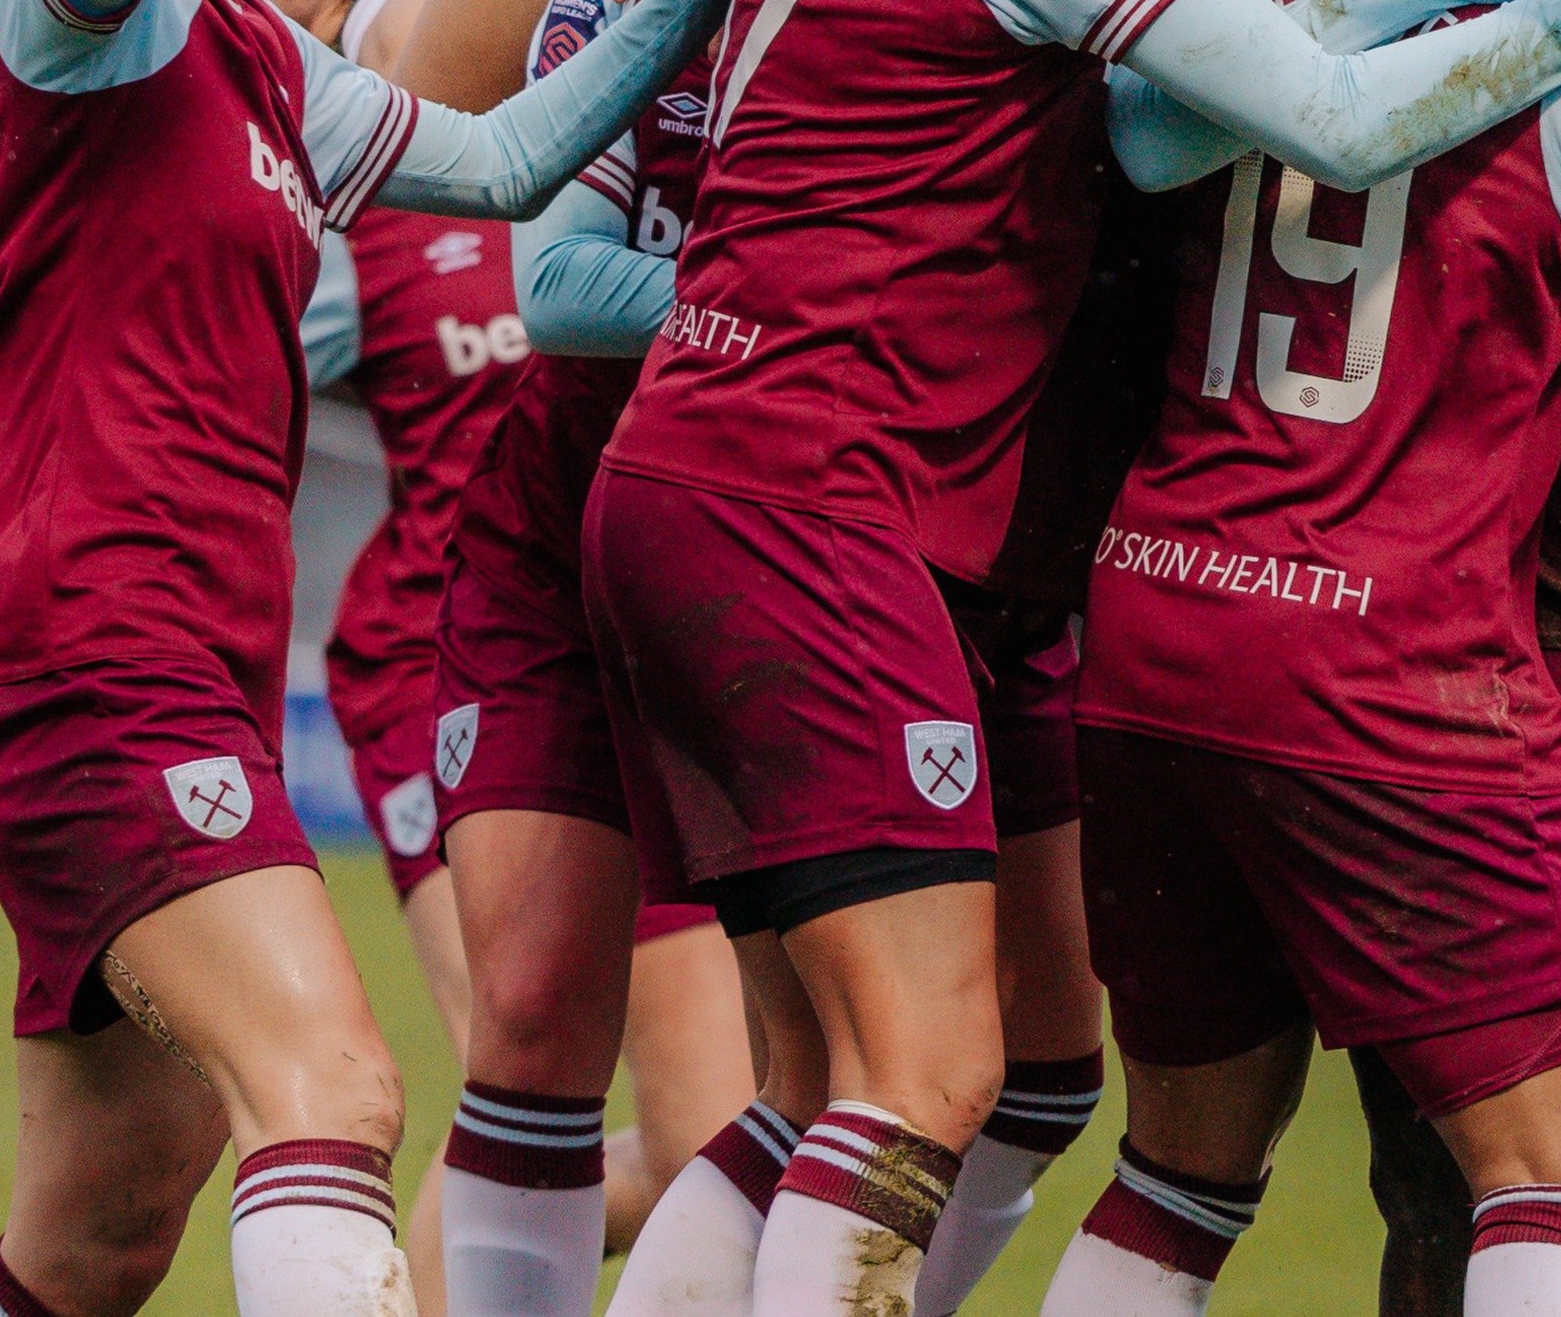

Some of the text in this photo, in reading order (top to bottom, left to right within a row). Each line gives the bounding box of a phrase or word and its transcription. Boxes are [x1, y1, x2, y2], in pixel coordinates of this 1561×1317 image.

[658, 117, 705, 137] umbro
[246, 120, 325, 251] betw
[1200, 147, 1414, 424] 19
[1114, 532, 1200, 582] SKIN
[1197, 550, 1373, 616] HEALTH
[914, 726, 966, 740] WEST HAM
